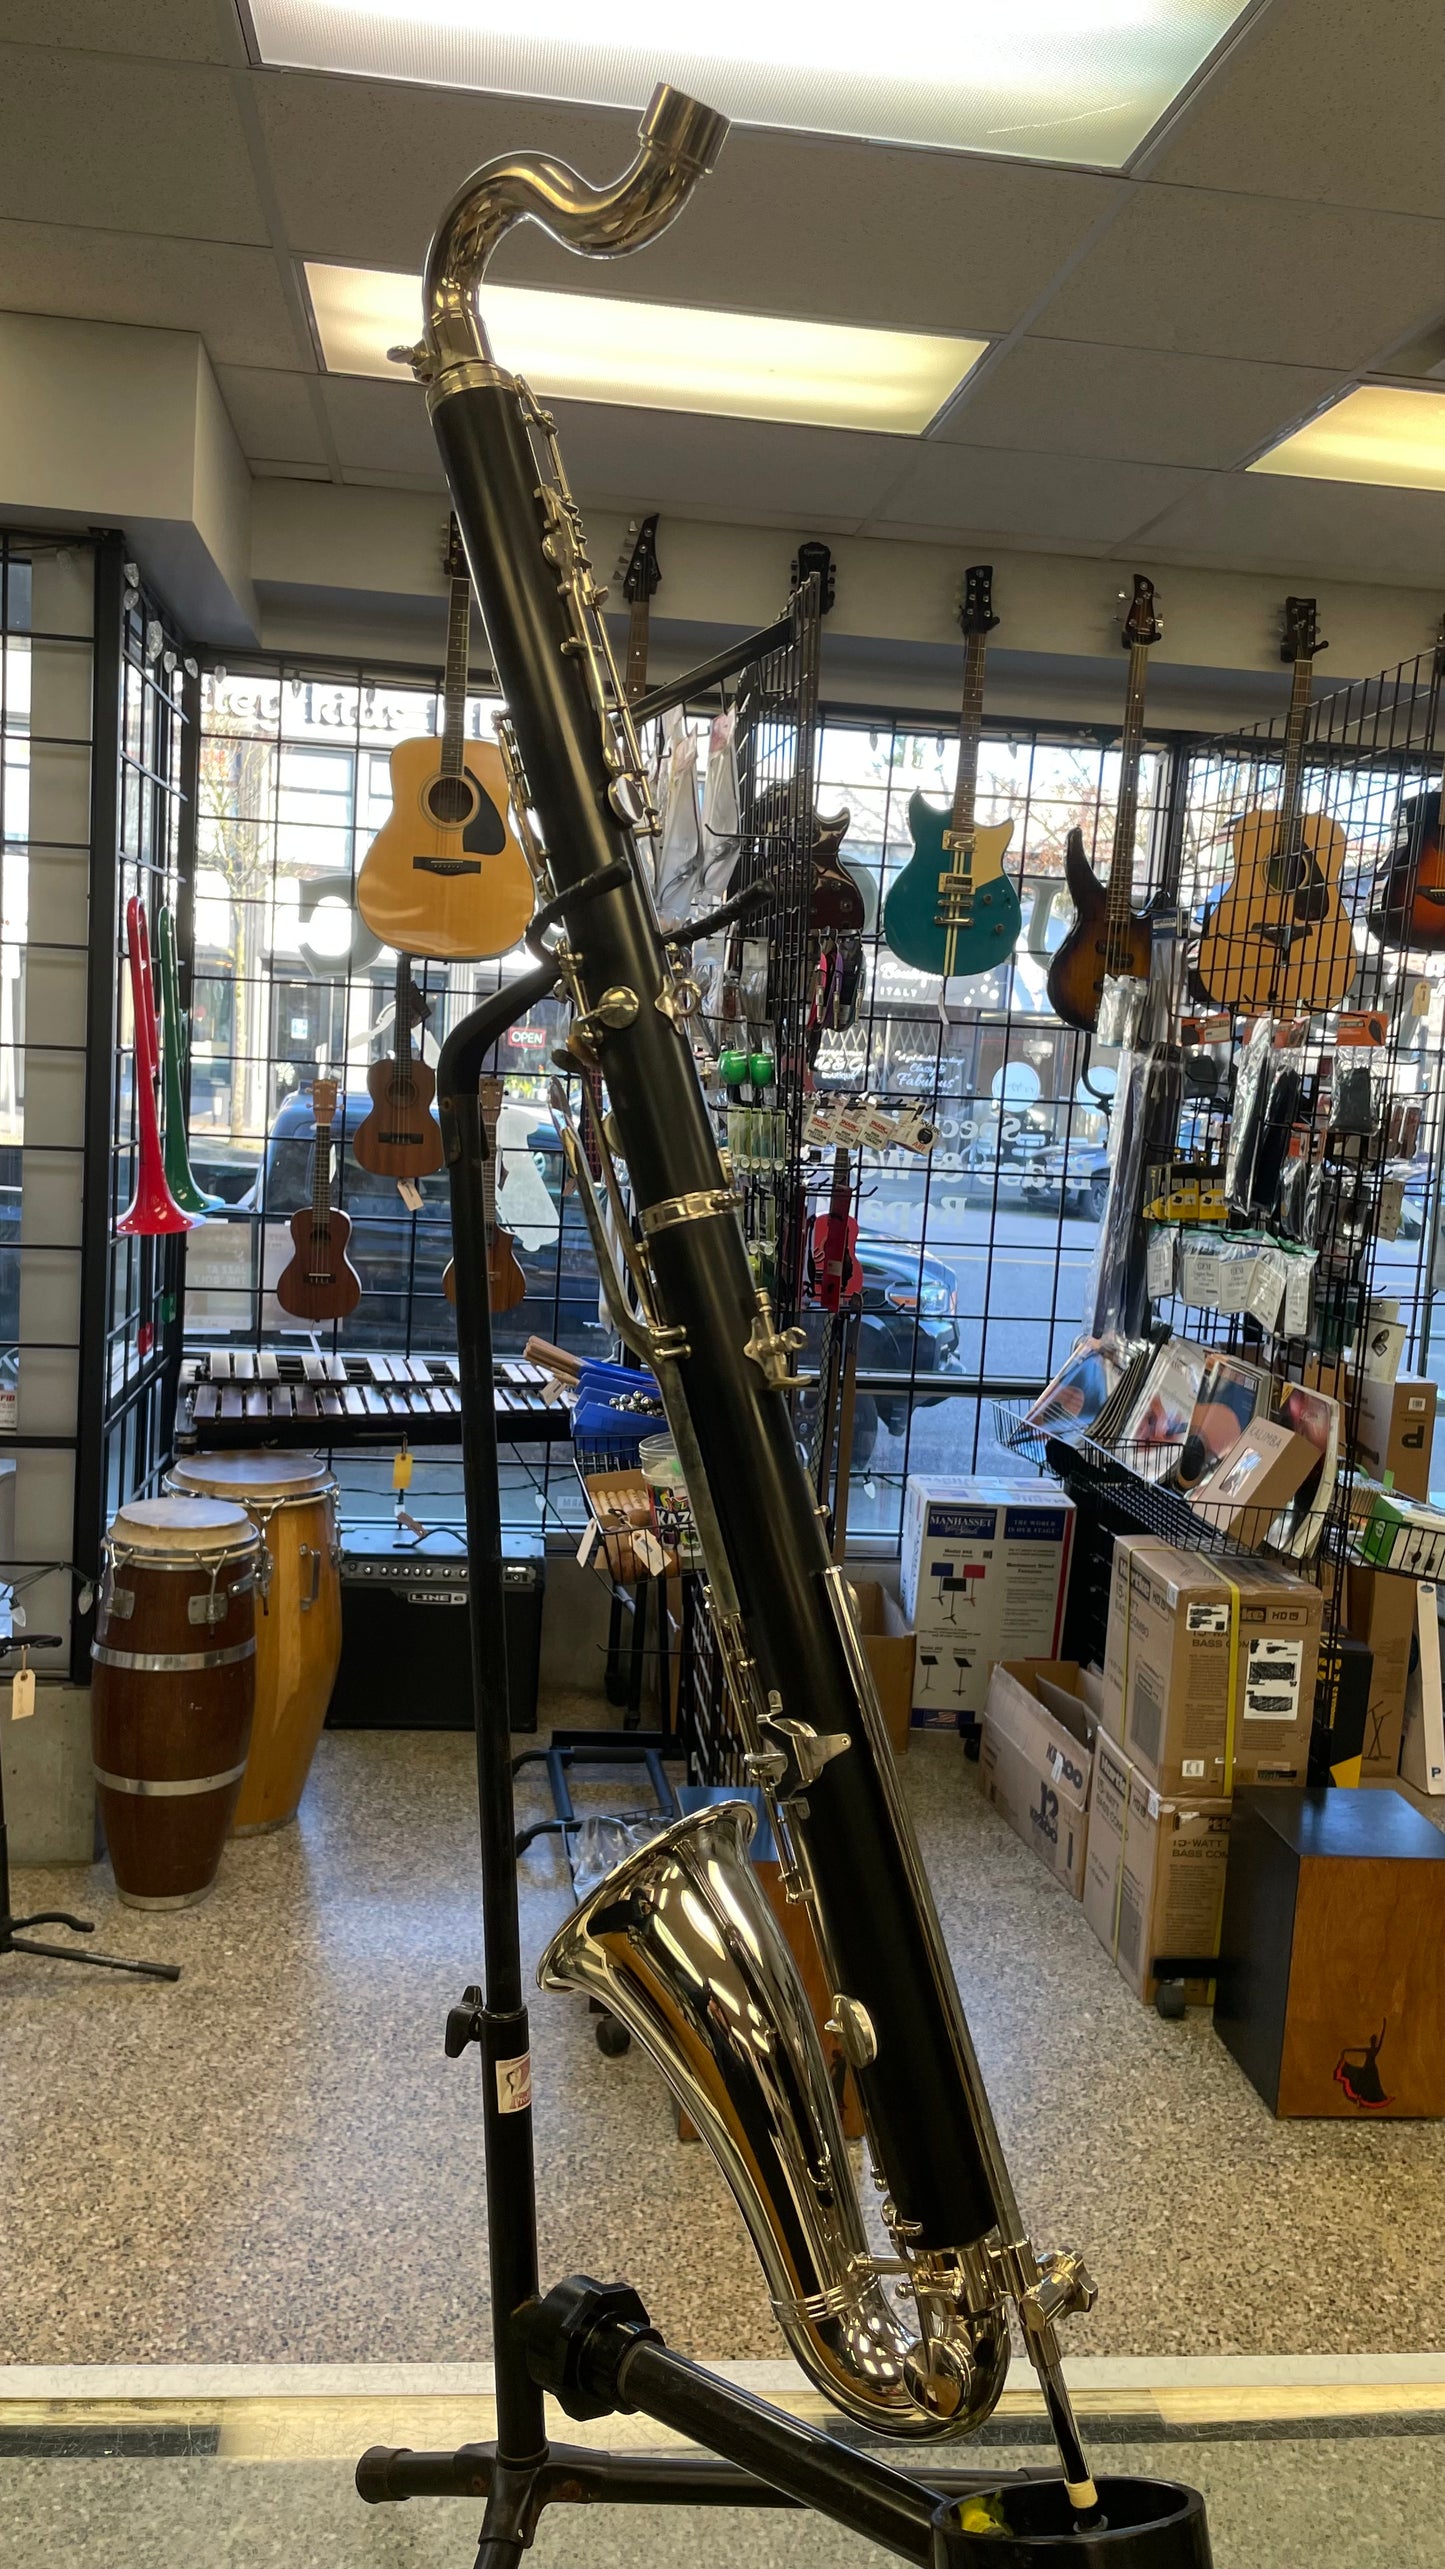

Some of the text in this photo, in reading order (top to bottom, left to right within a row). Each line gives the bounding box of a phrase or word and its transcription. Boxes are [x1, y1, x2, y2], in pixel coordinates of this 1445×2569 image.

[511, 1031, 542, 1044] OPEN
[1250, 1424, 1282, 1450] KALIMBA
[929, 1515, 993, 1528] MANHASSET
[411, 1593, 450, 1602] LINE
[1191, 1638, 1223, 1648] BASS
[1171, 1848, 1202, 1858] BASS
